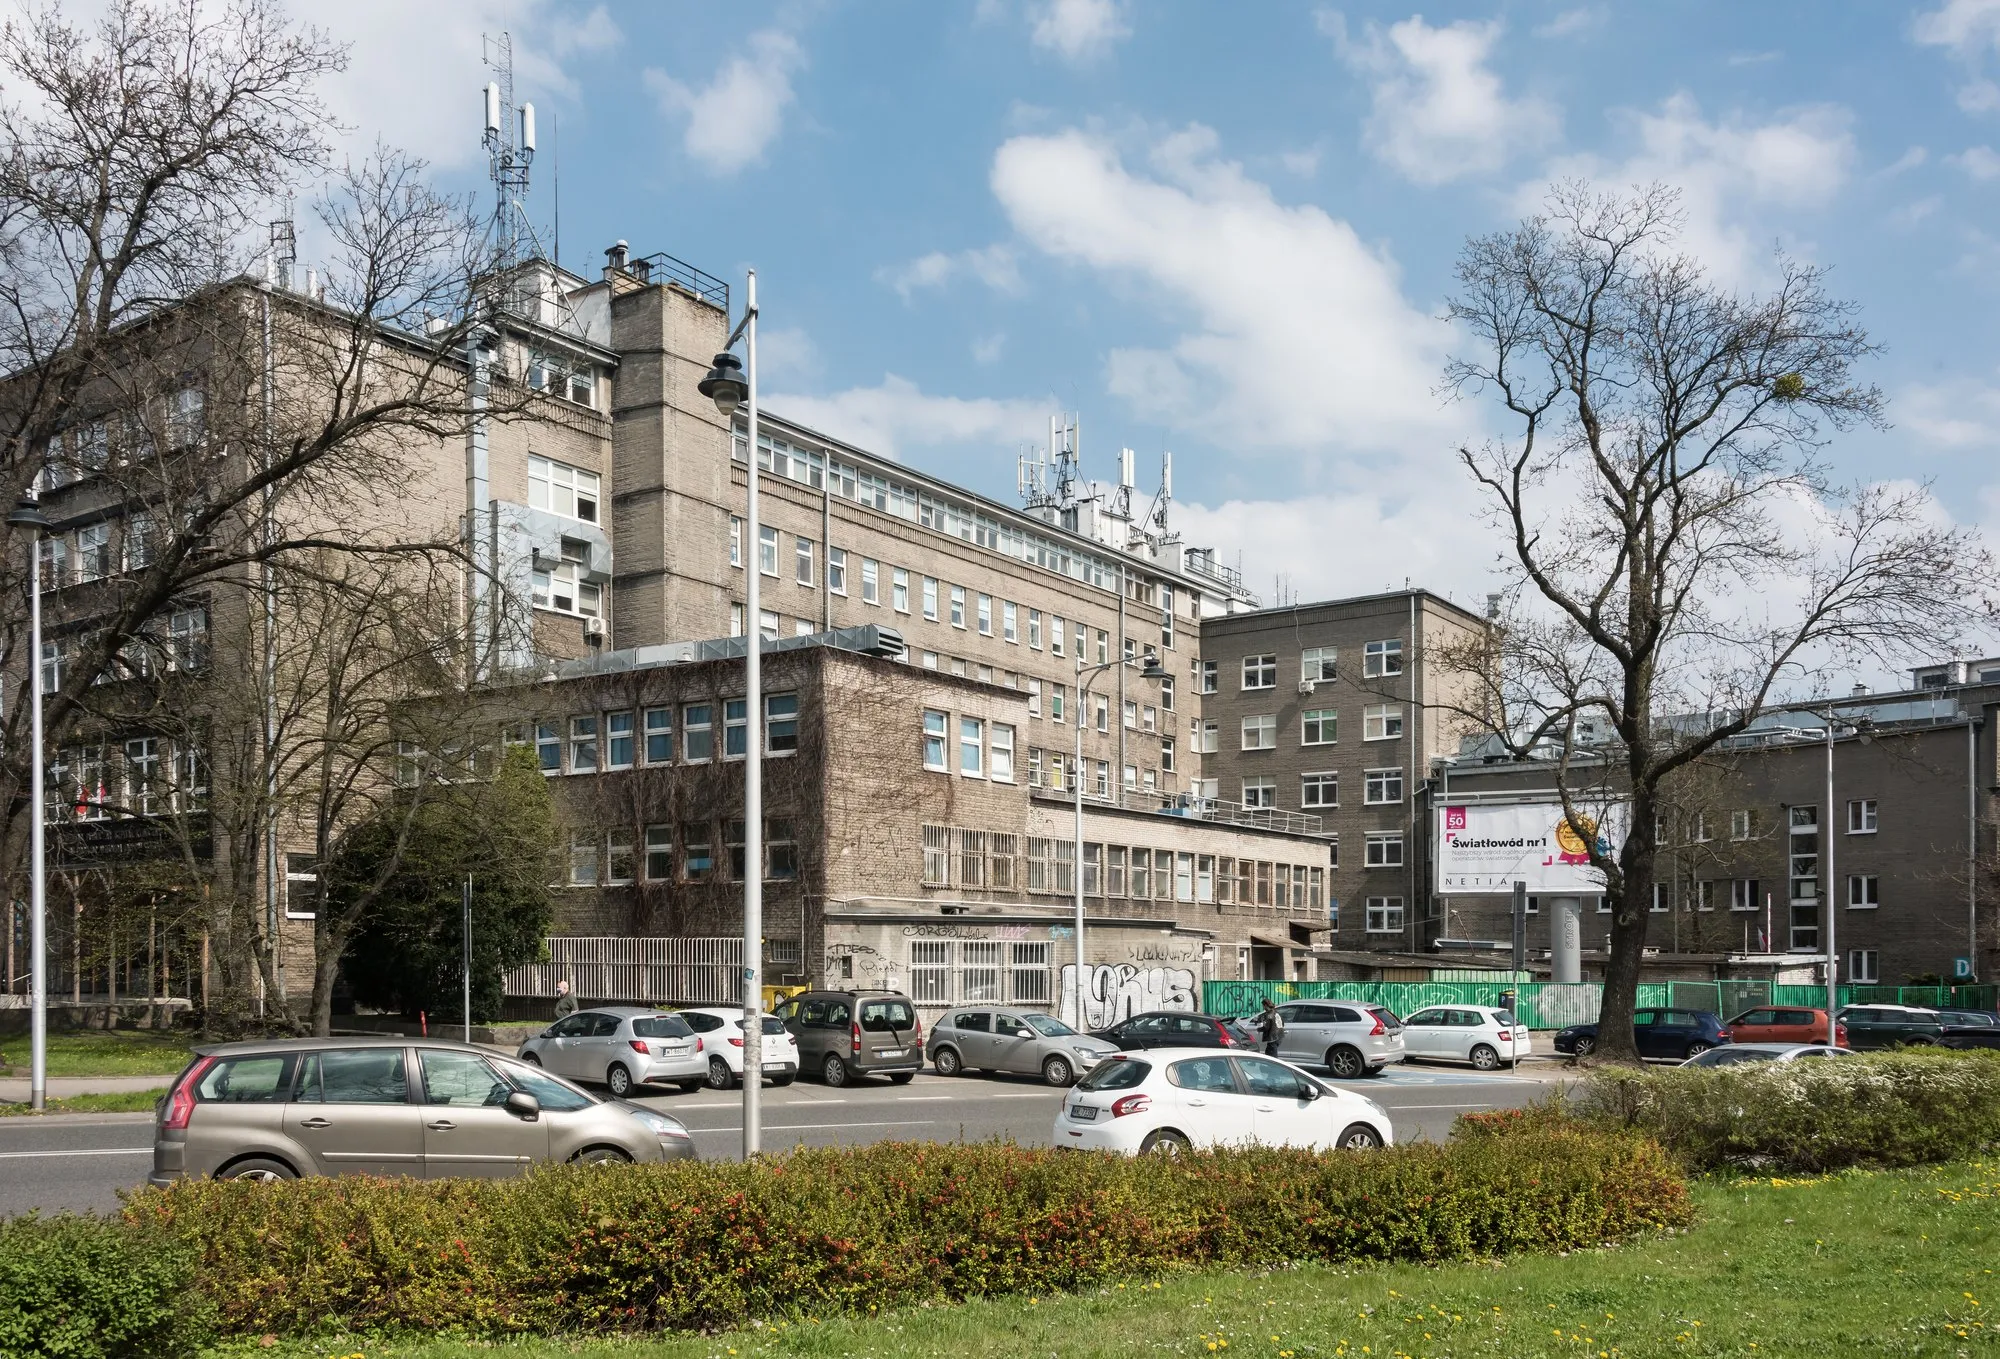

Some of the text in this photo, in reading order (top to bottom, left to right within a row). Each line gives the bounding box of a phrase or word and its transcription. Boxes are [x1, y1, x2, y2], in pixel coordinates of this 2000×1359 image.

[1448, 817, 1464, 826] 50
[1452, 838, 1547, 848] Światłowód nr 1
[1445, 878, 1507, 886] NETIA
[1956, 959, 1970, 977] D
